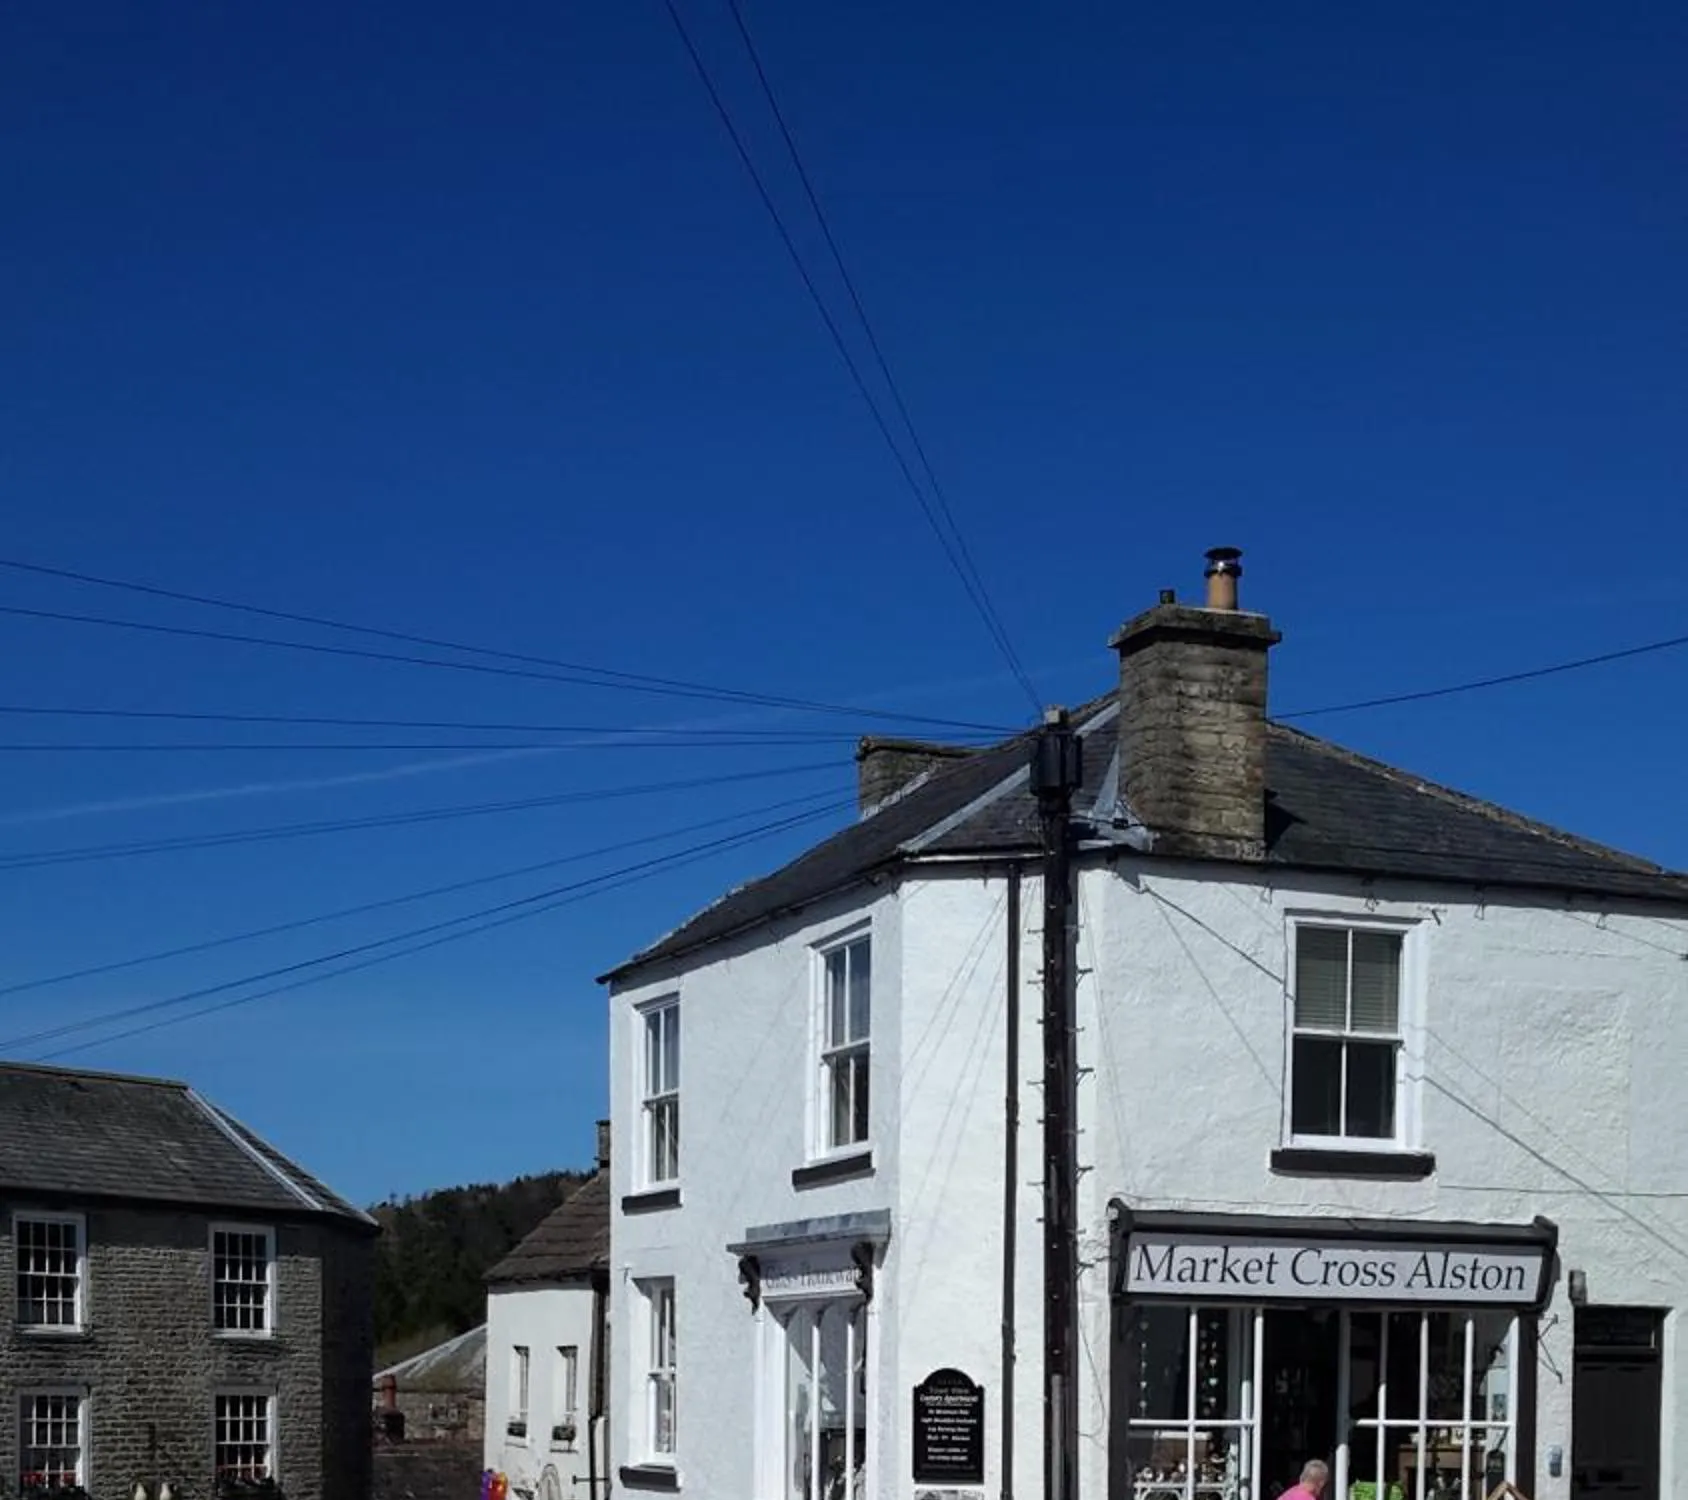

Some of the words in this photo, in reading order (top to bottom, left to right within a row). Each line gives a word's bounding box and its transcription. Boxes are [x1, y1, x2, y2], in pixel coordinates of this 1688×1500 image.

[1133, 1243, 1278, 1286] Market
[1291, 1247, 1396, 1288] Cross
[1404, 1250, 1526, 1292] Alston
